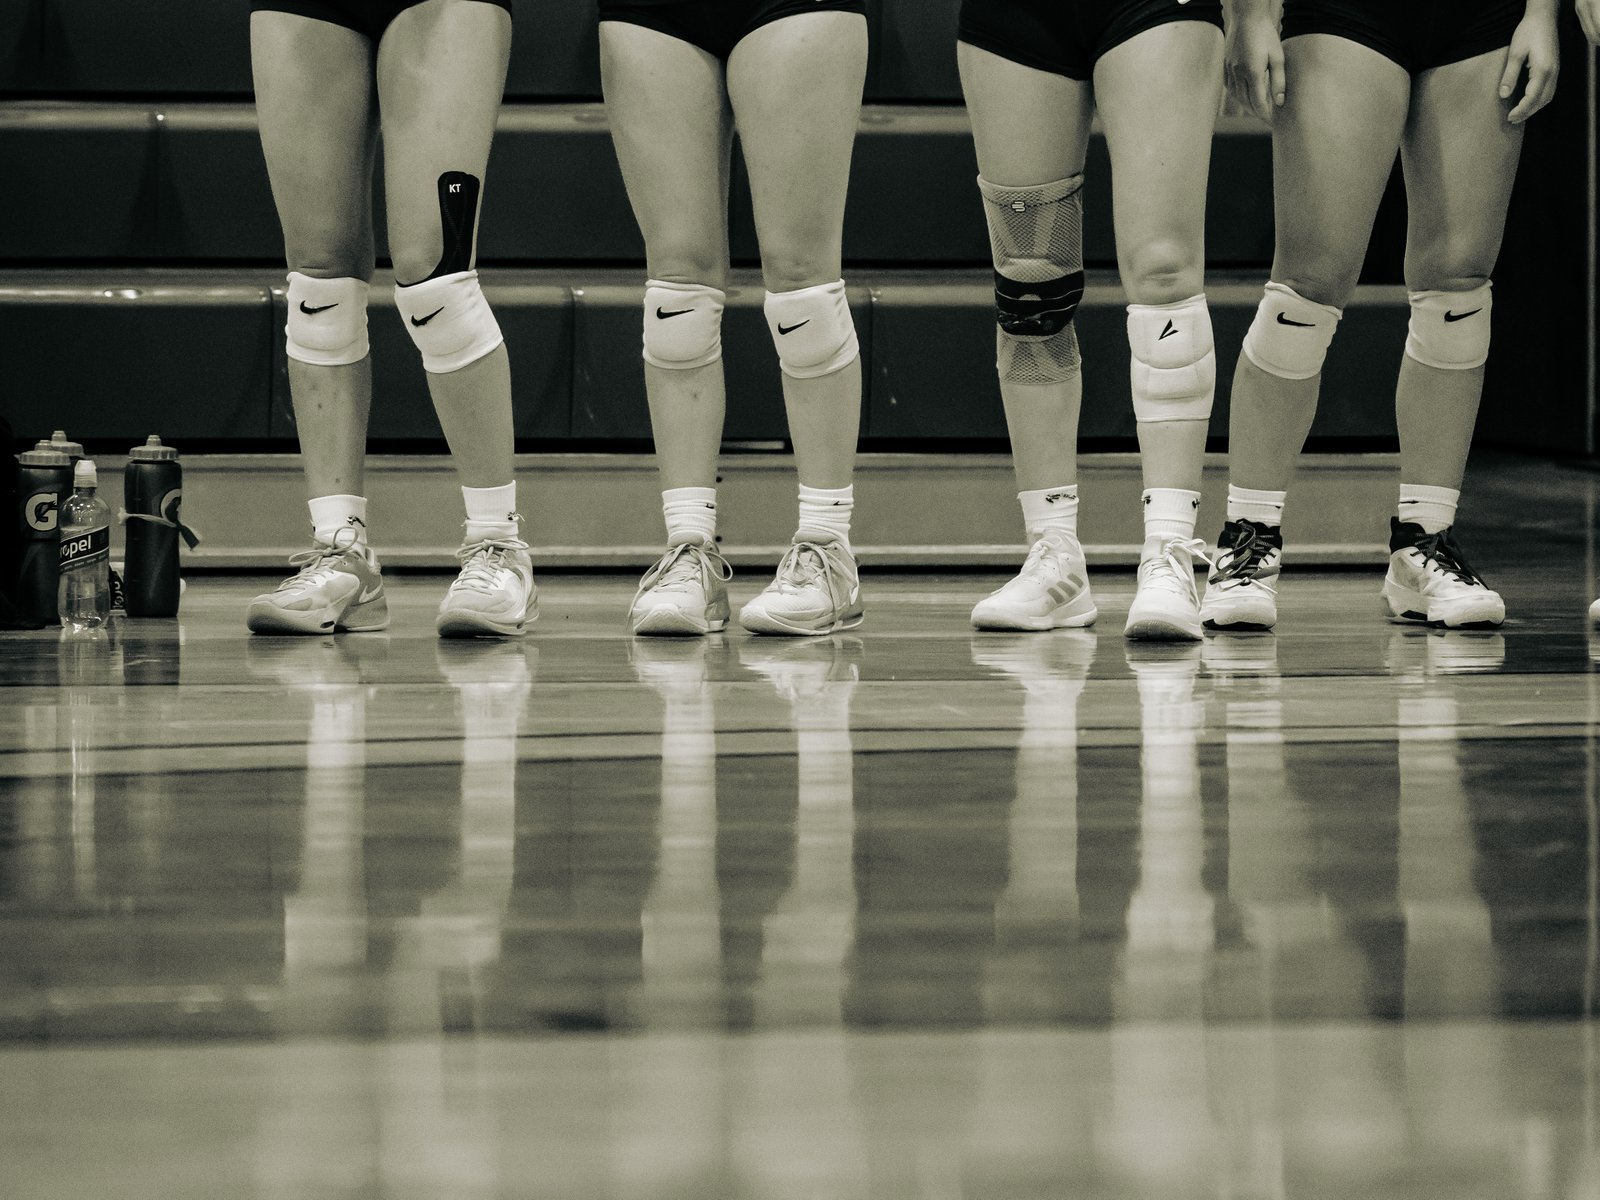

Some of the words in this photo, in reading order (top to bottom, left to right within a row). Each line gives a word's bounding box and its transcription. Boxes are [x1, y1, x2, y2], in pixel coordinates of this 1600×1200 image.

[449, 183, 462, 193] KT
[25, 492, 58, 531] G
[60, 534, 92, 558] ropel
